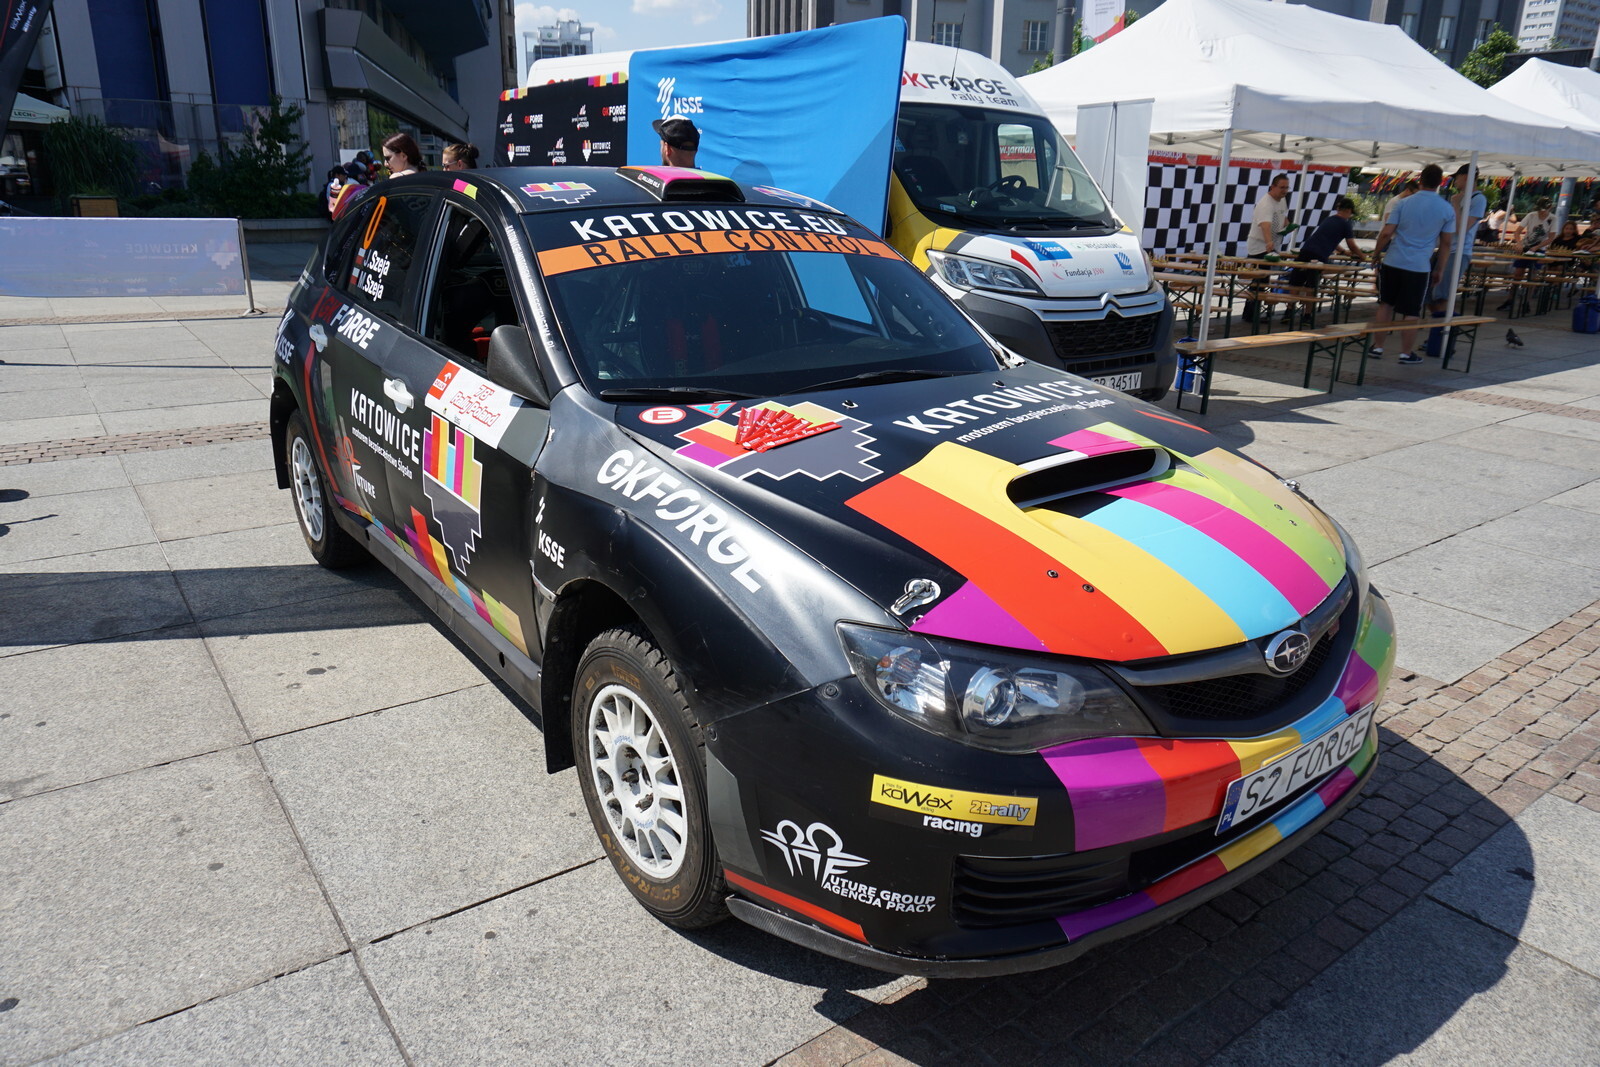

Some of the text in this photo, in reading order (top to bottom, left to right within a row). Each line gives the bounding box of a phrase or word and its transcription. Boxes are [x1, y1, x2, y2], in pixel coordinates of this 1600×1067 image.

[673, 96, 704, 114] KSSE
[952, 92, 1019, 107] rally team
[515, 145, 531, 153] KATOWICE
[592, 141, 611, 150] KATOWICE
[570, 209, 848, 241] KATOWICE.EU
[581, 231, 712, 266] RALLY
[724, 229, 881, 257] CONTROL
[363, 248, 391, 278] J.Szeja
[1065, 269, 1093, 277] Fundacja
[357, 271, 384, 301] M.Szeja
[652, 409, 673, 421] E
[892, 380, 1100, 434] KATOWICE
[351, 388, 420, 465] KATOWICE
[956, 417, 1015, 443] motorem
[596, 449, 762, 594] GKFORGE
[538, 529, 565, 569] KSSE
[1241, 711, 1369, 816] S2 FORGE
[881, 783, 953, 811] koWax
[969, 800, 1031, 821] 2Brally
[923, 814, 983, 838] racing
[1221, 811, 1233, 825] PL
[823, 881, 936, 913] AGENCJA PRACY
[879, 889, 936, 906] GROUP
